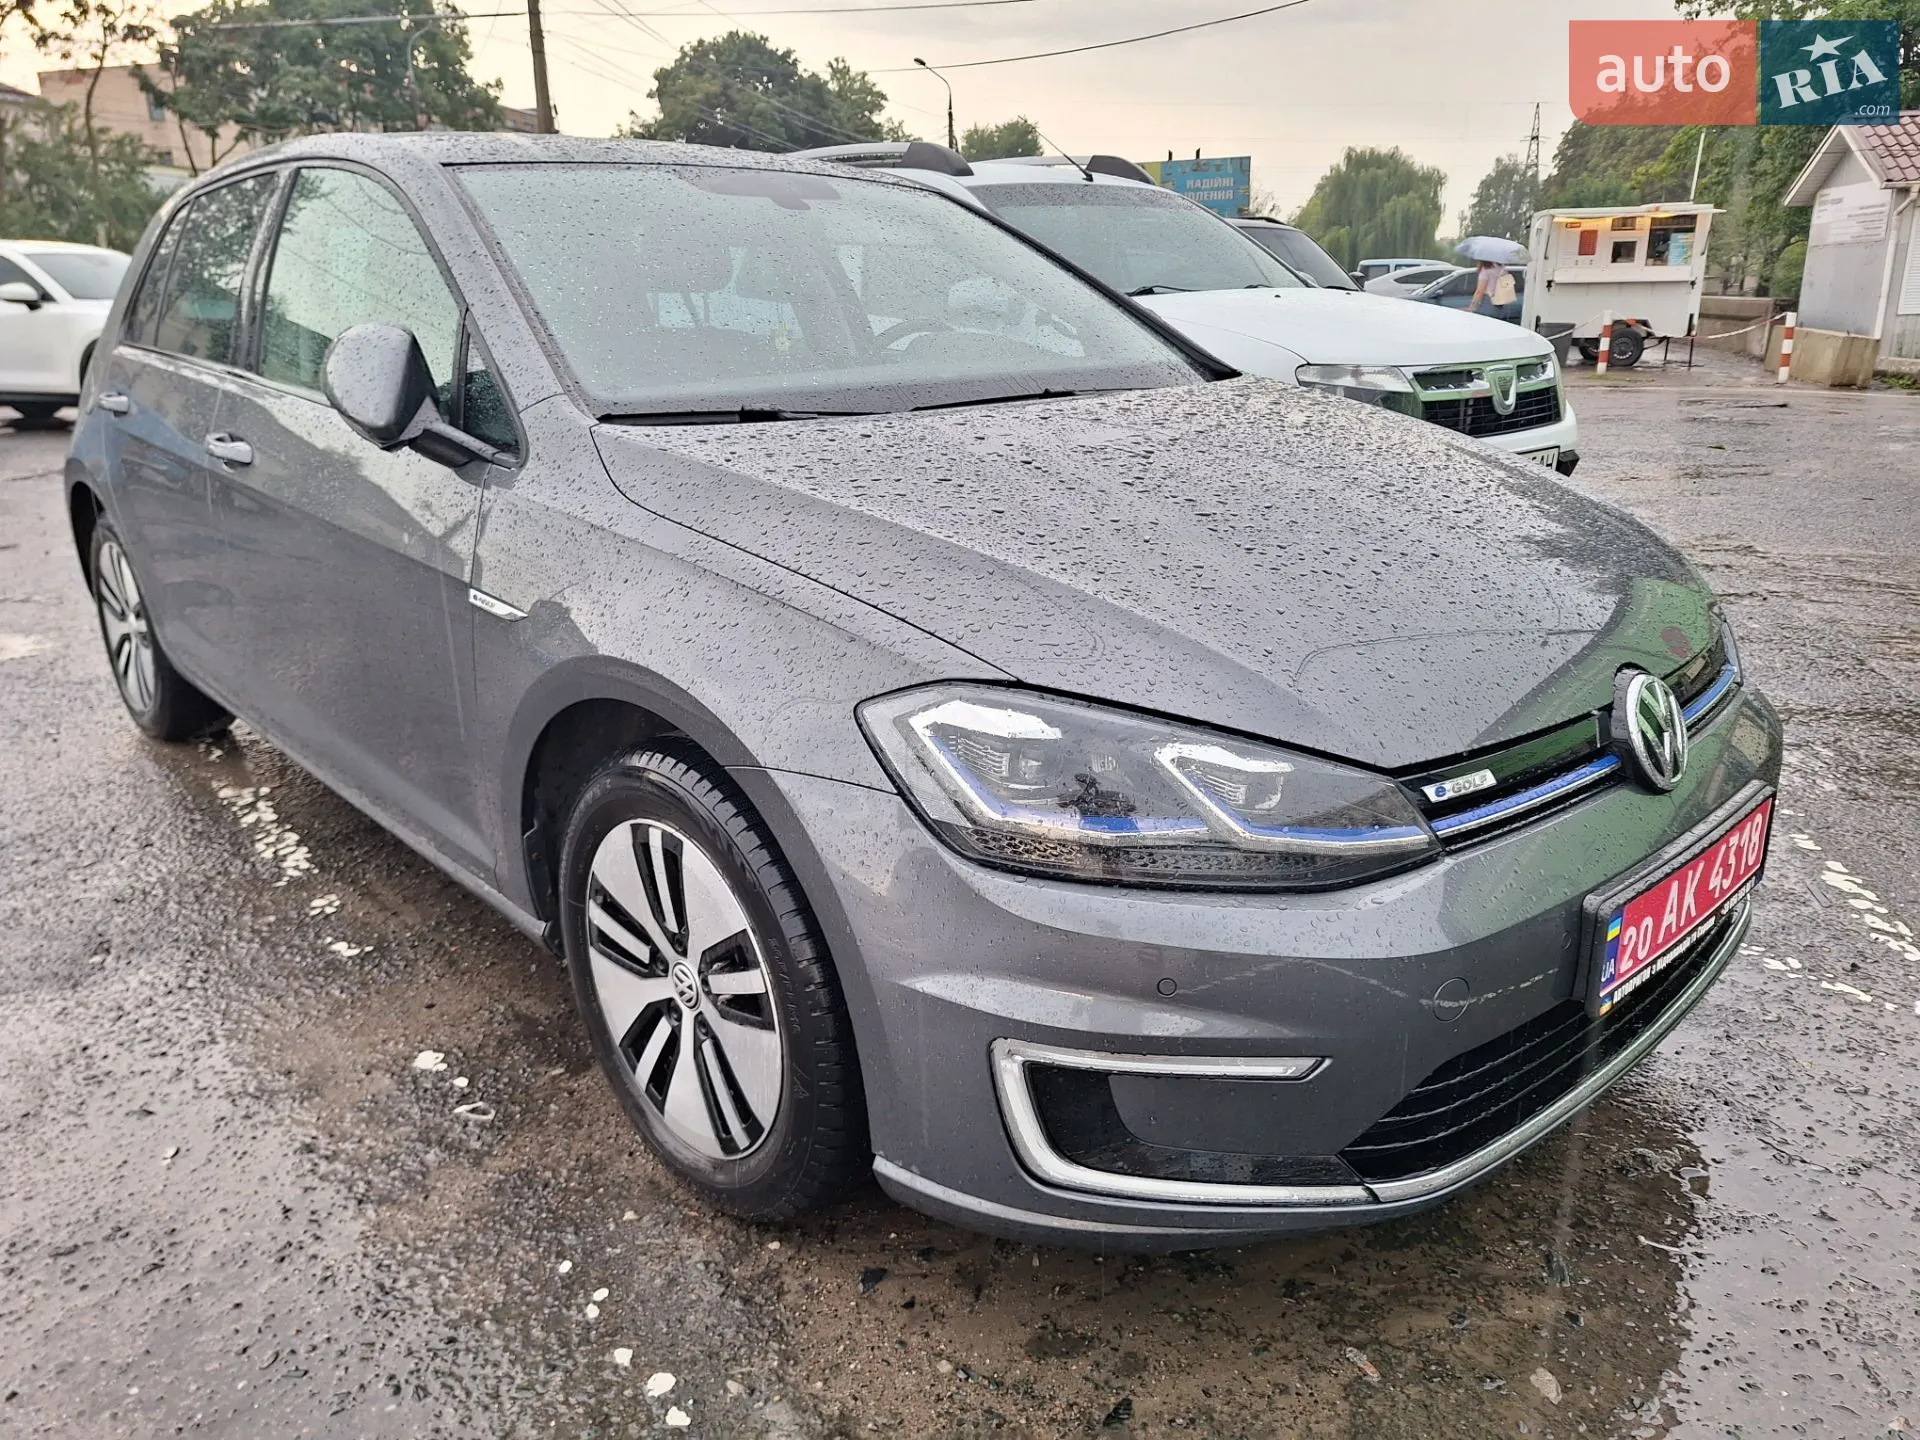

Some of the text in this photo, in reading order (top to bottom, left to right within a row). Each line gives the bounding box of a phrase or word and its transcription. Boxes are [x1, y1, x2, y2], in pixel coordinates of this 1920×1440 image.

[1186, 177, 1234, 189] НАДІЙНІ
[1619, 916, 1654, 974] 20
[1657, 860, 1705, 945] AK
[1707, 812, 1764, 899] 4318
[1600, 961, 1616, 983] UA
